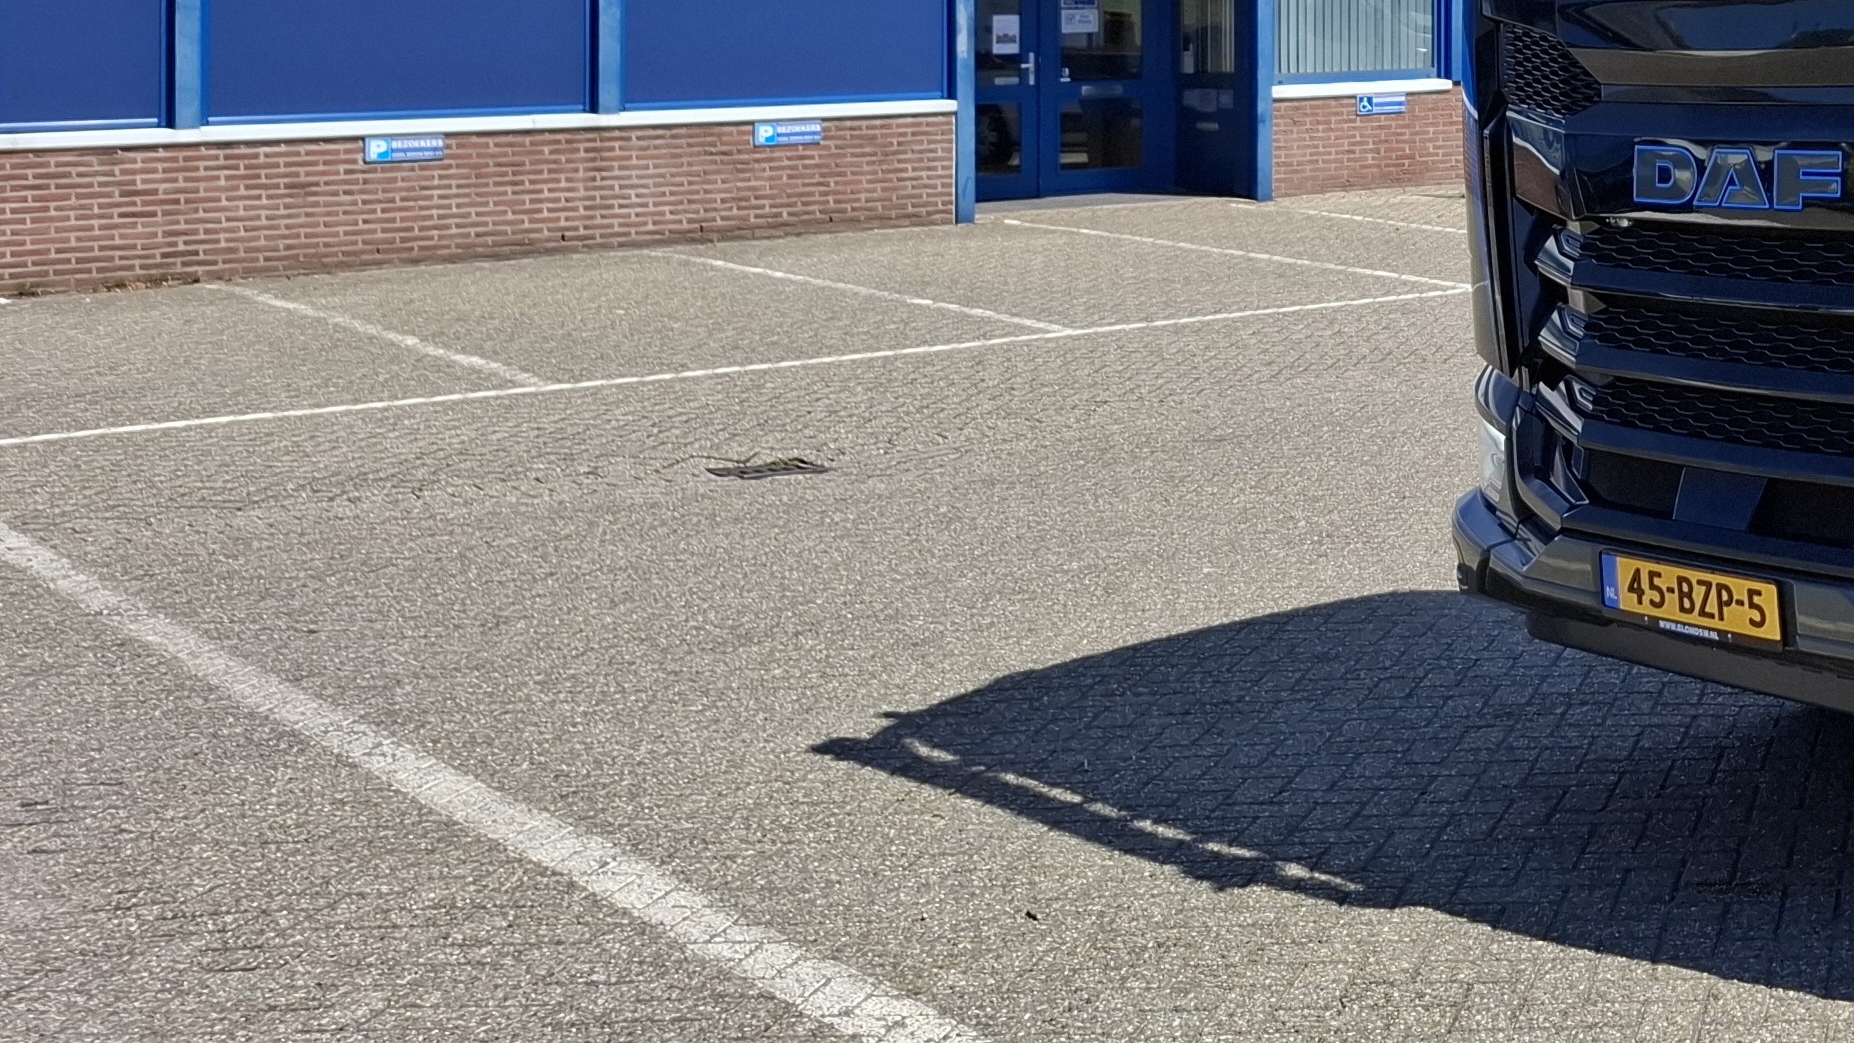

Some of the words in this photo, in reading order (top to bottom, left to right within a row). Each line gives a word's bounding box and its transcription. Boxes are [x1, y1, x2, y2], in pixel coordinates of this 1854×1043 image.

[1634, 145, 1842, 210] DAF
[1606, 586, 1618, 600] NL
[1627, 567, 1767, 628] 45-BZP-5
